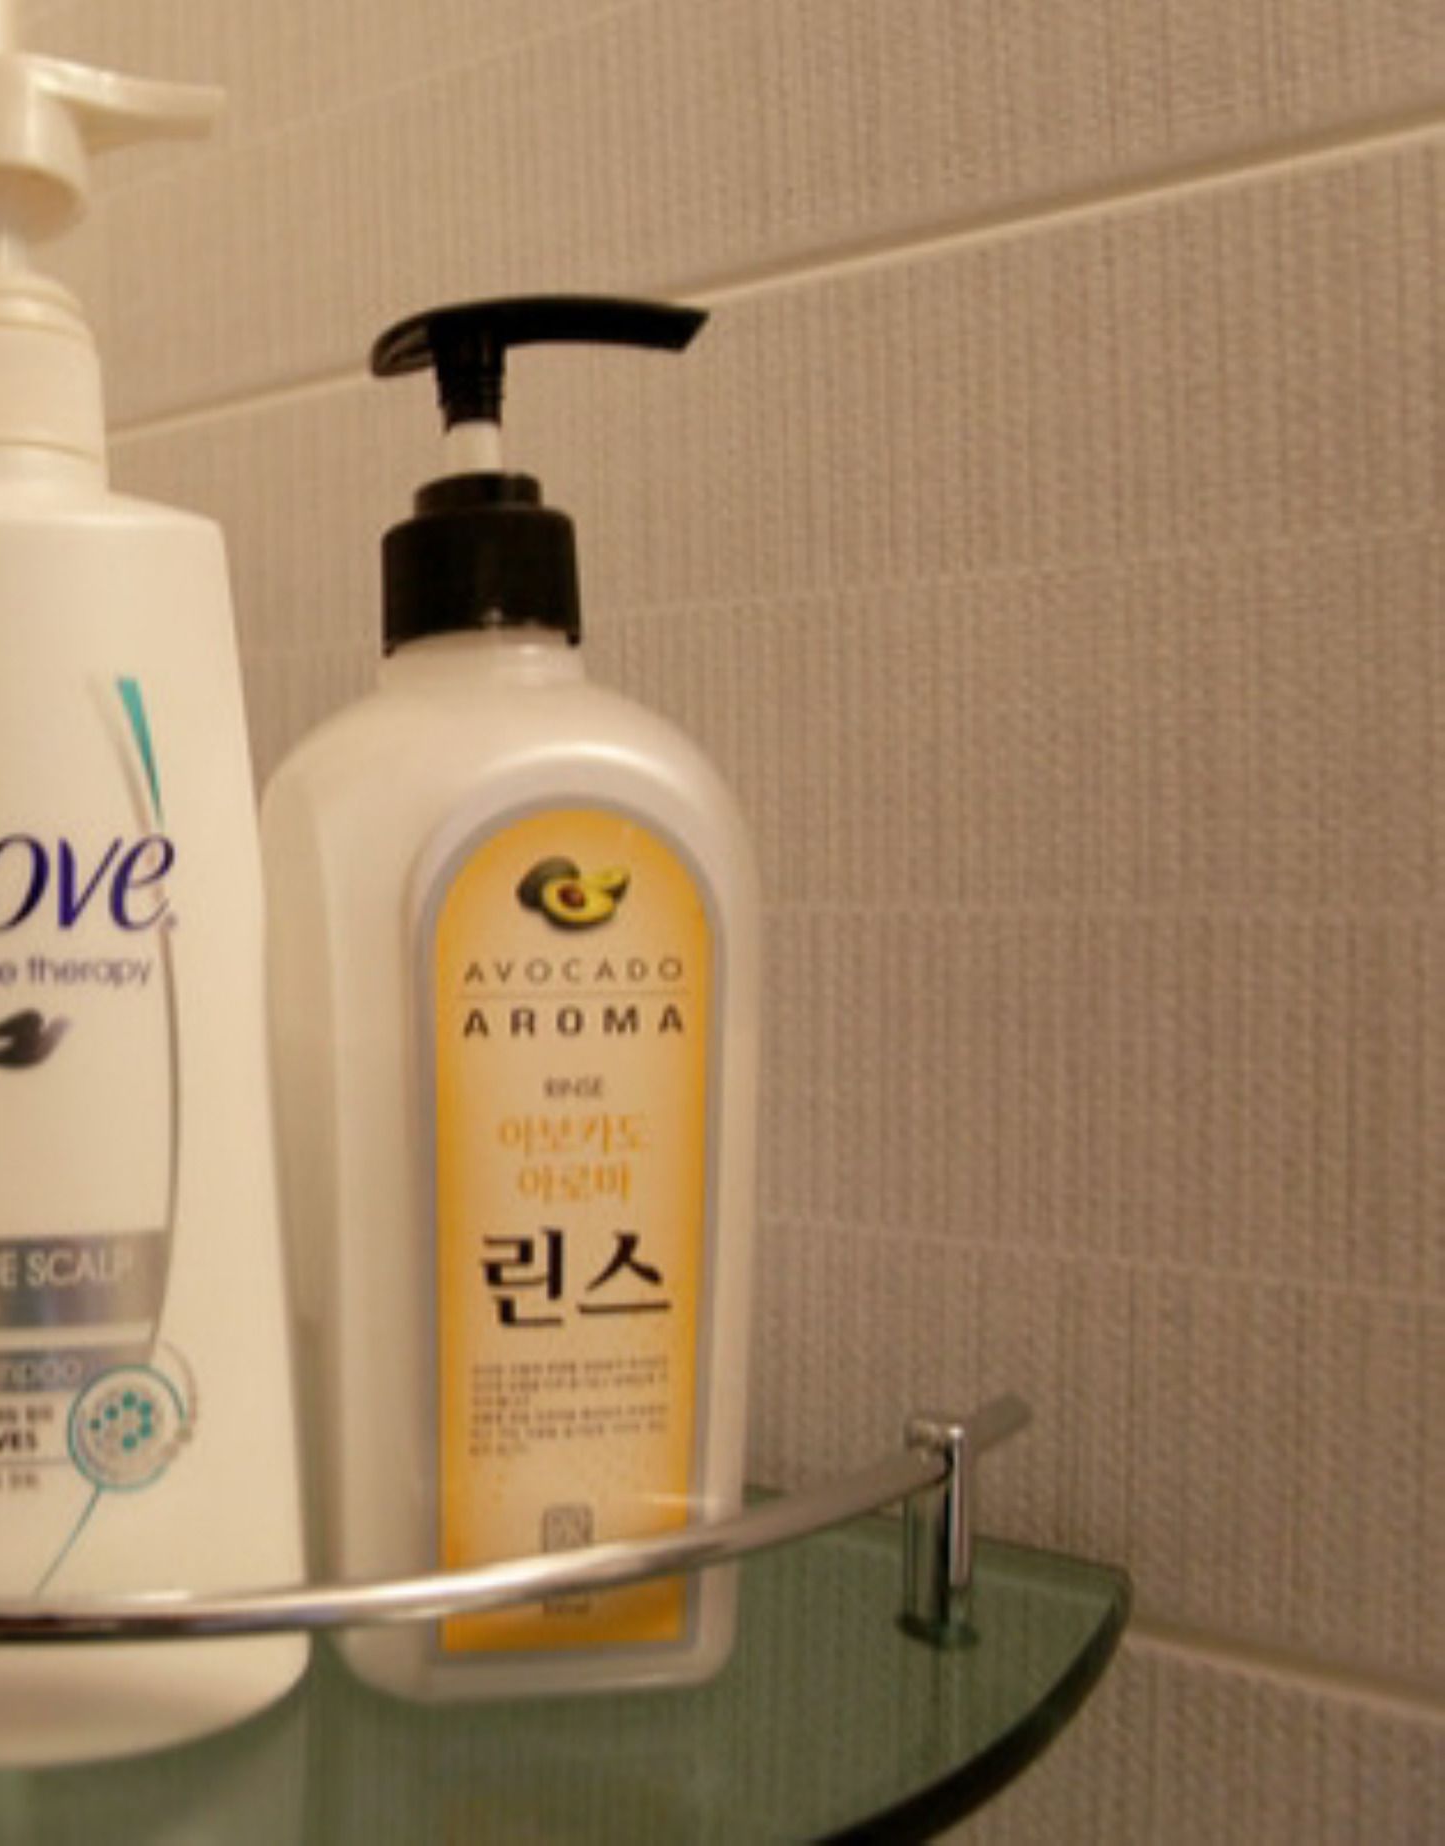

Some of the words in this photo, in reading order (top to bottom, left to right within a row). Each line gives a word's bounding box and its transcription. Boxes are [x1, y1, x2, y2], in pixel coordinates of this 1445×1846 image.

[28, 954, 153, 987] therapy
[464, 957, 684, 985] AVOCADO
[464, 1004, 684, 1038] AROMA
[498, 1112, 648, 1157] 아보카도
[519, 1161, 632, 1204] 아로마
[480, 1226, 673, 1328] 린스
